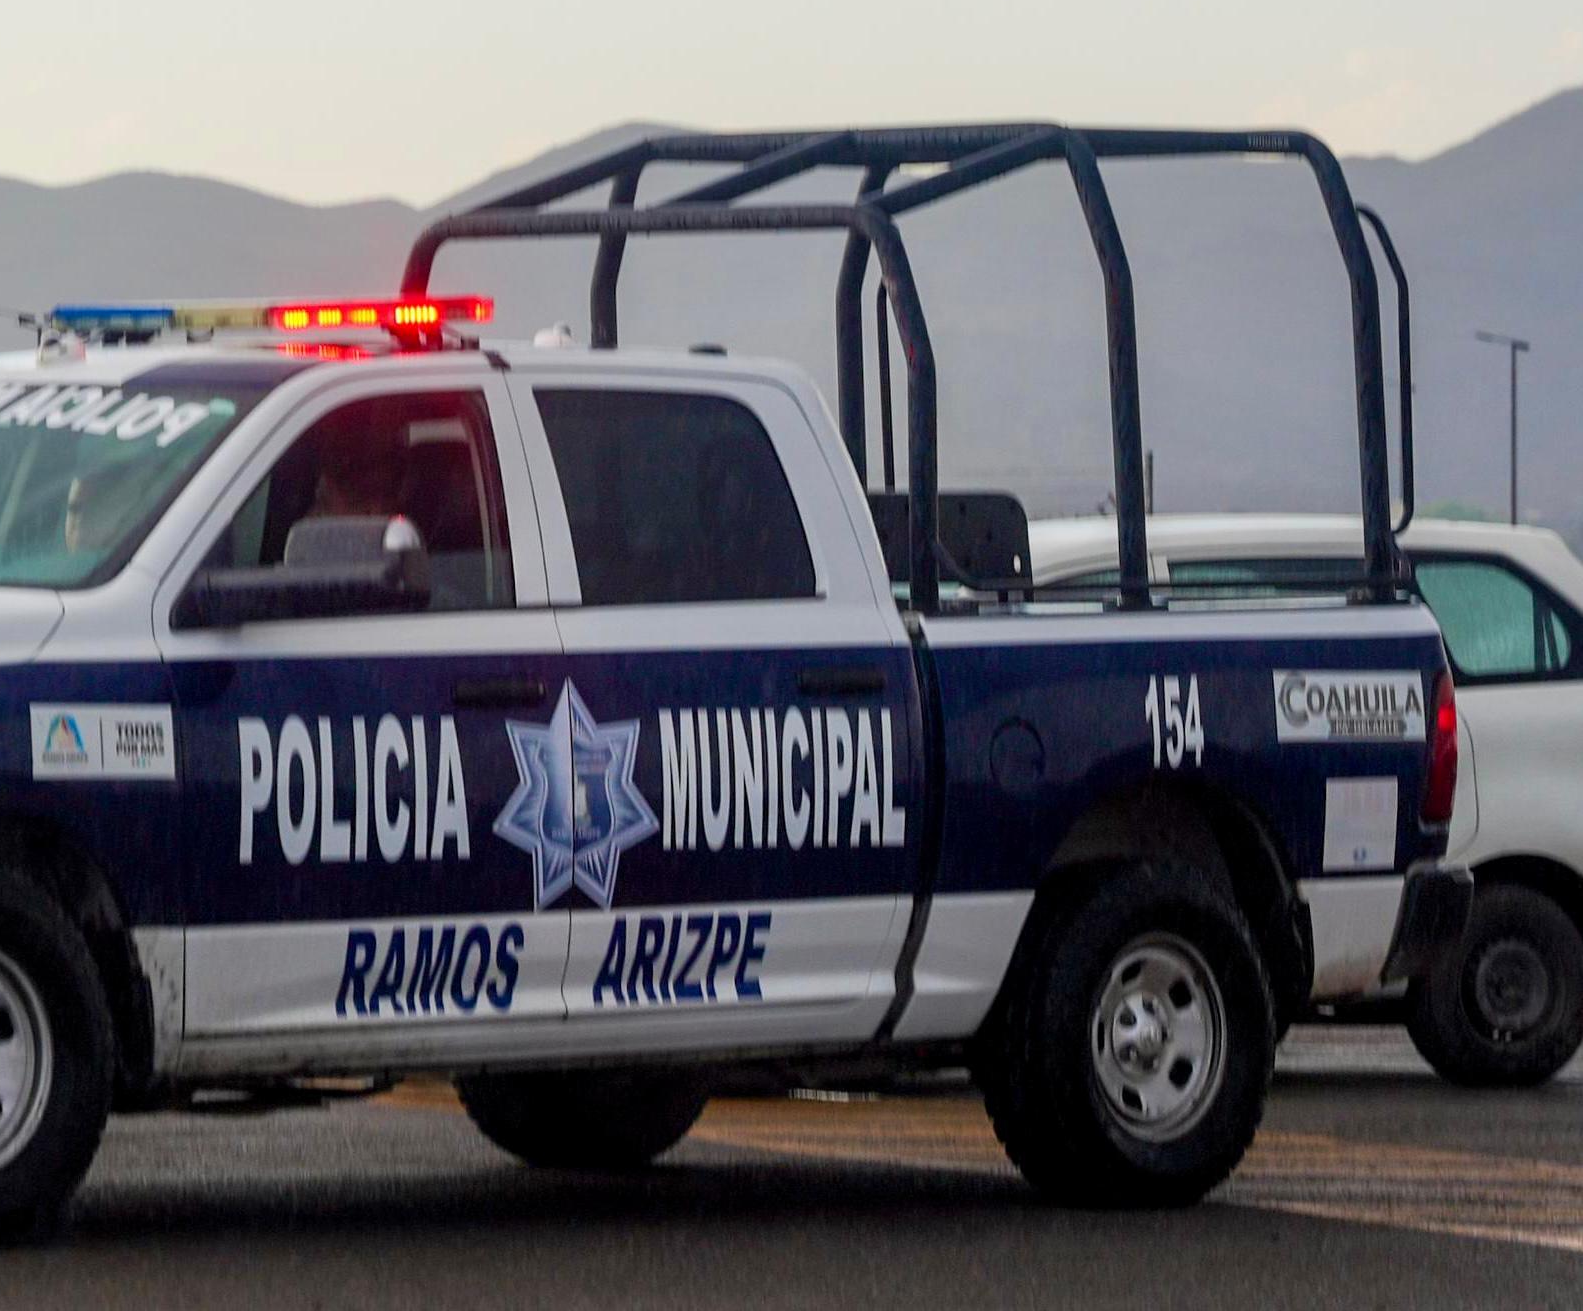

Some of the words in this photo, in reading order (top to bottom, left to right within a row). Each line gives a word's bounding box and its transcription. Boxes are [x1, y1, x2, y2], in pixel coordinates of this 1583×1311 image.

[1145, 672, 1205, 770] 154
[1278, 670, 1423, 729] COAHUILA
[237, 714, 471, 866] POLICIA
[657, 704, 905, 853] MUNICIPAL
[334, 923, 525, 1017] RAMOS
[593, 911, 773, 1006] ARIZPE
